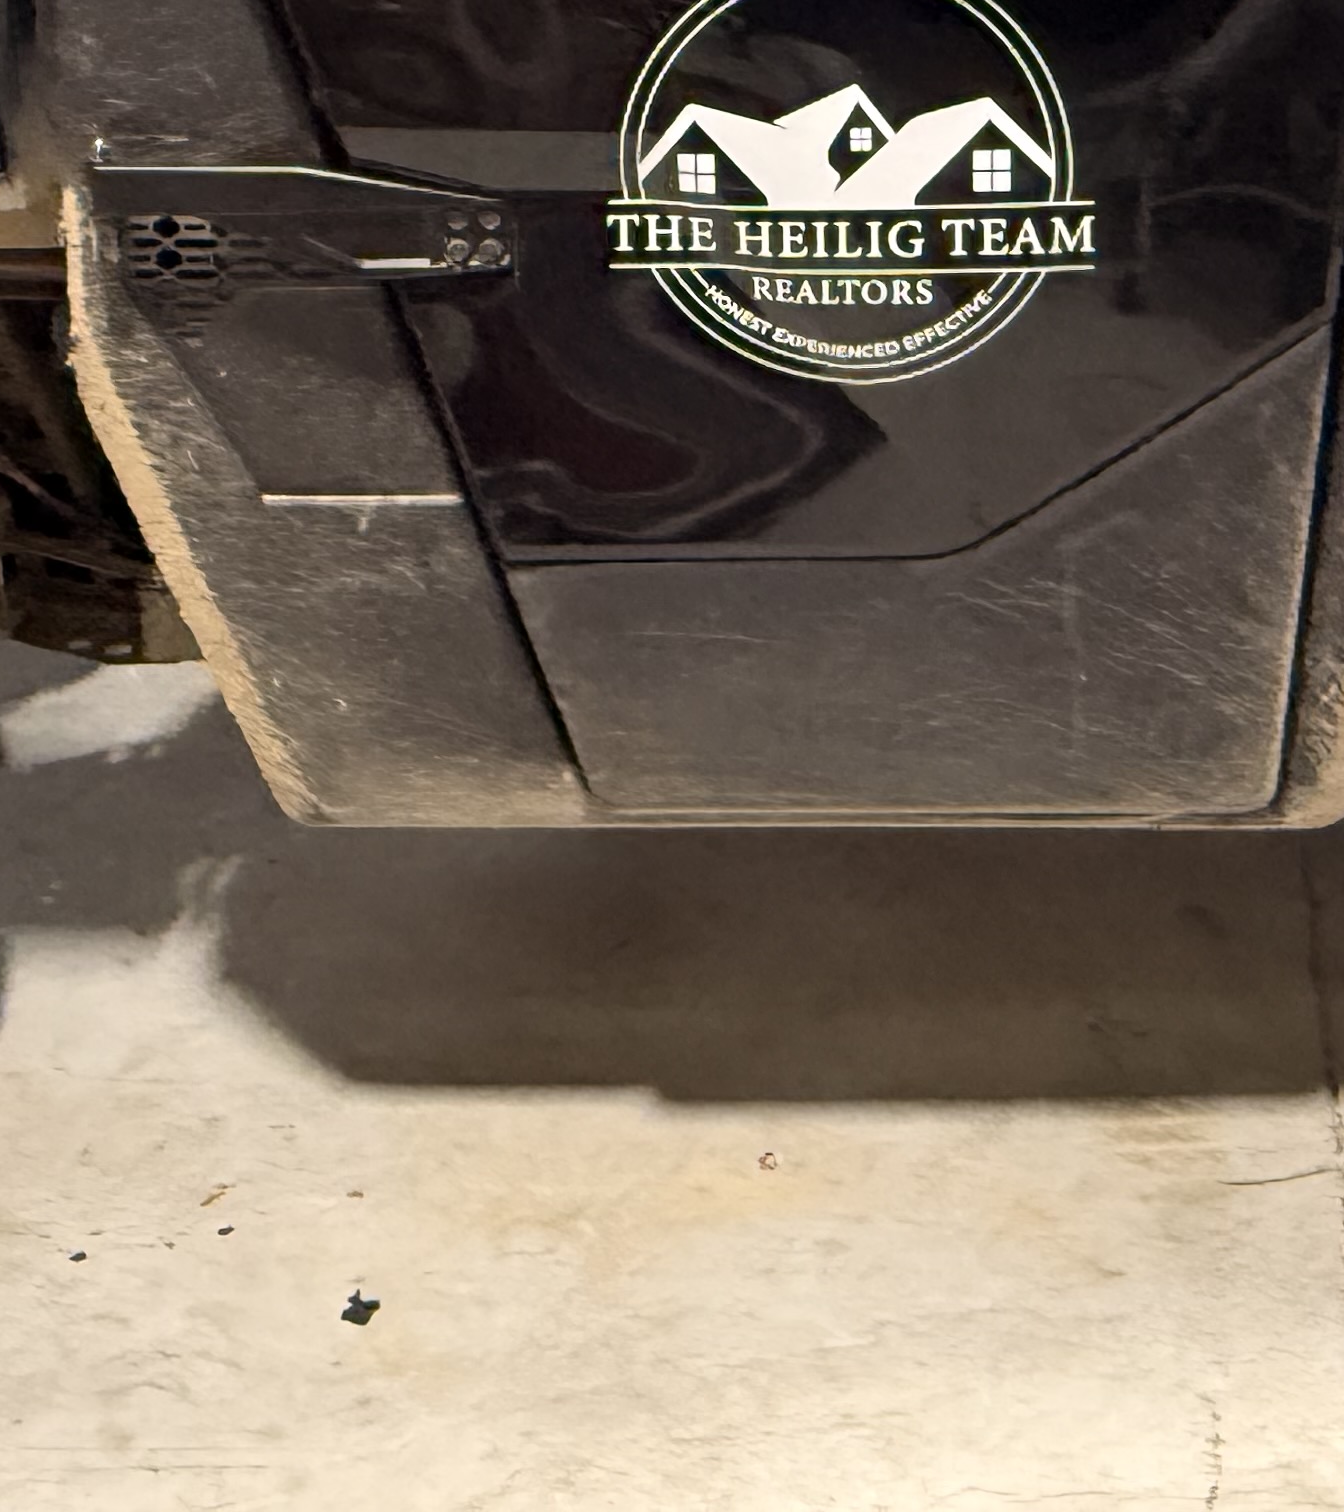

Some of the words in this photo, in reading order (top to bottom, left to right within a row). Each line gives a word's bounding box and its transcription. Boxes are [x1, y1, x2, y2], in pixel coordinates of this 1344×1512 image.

[605, 214, 717, 253] THE
[734, 220, 925, 259] HEILIG
[941, 215, 1096, 257] TEAM
[752, 276, 934, 306] REALTORS
[704, 284, 773, 335] HONEST
[771, 327, 901, 360] EXPERIENCED
[903, 288, 995, 353] EFFECTIVE
